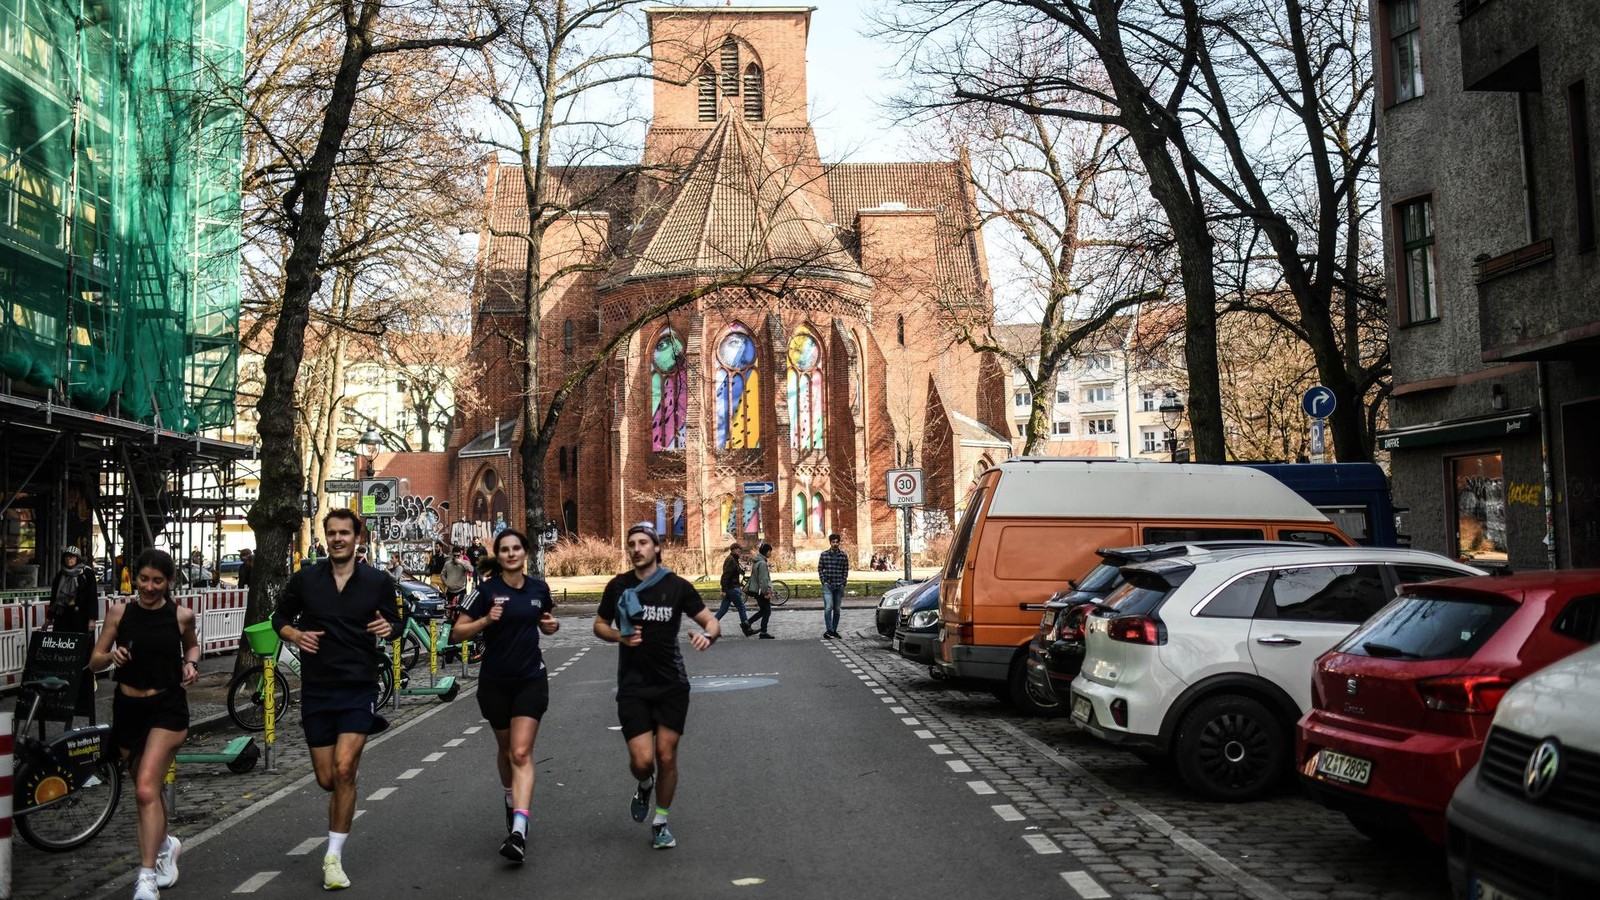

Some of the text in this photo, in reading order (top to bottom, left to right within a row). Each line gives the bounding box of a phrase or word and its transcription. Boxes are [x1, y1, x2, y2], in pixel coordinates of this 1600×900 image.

[898, 479, 912, 490] 30
[41, 636, 76, 649] fritz-kola
[1344, 759, 1369, 781] 2895
